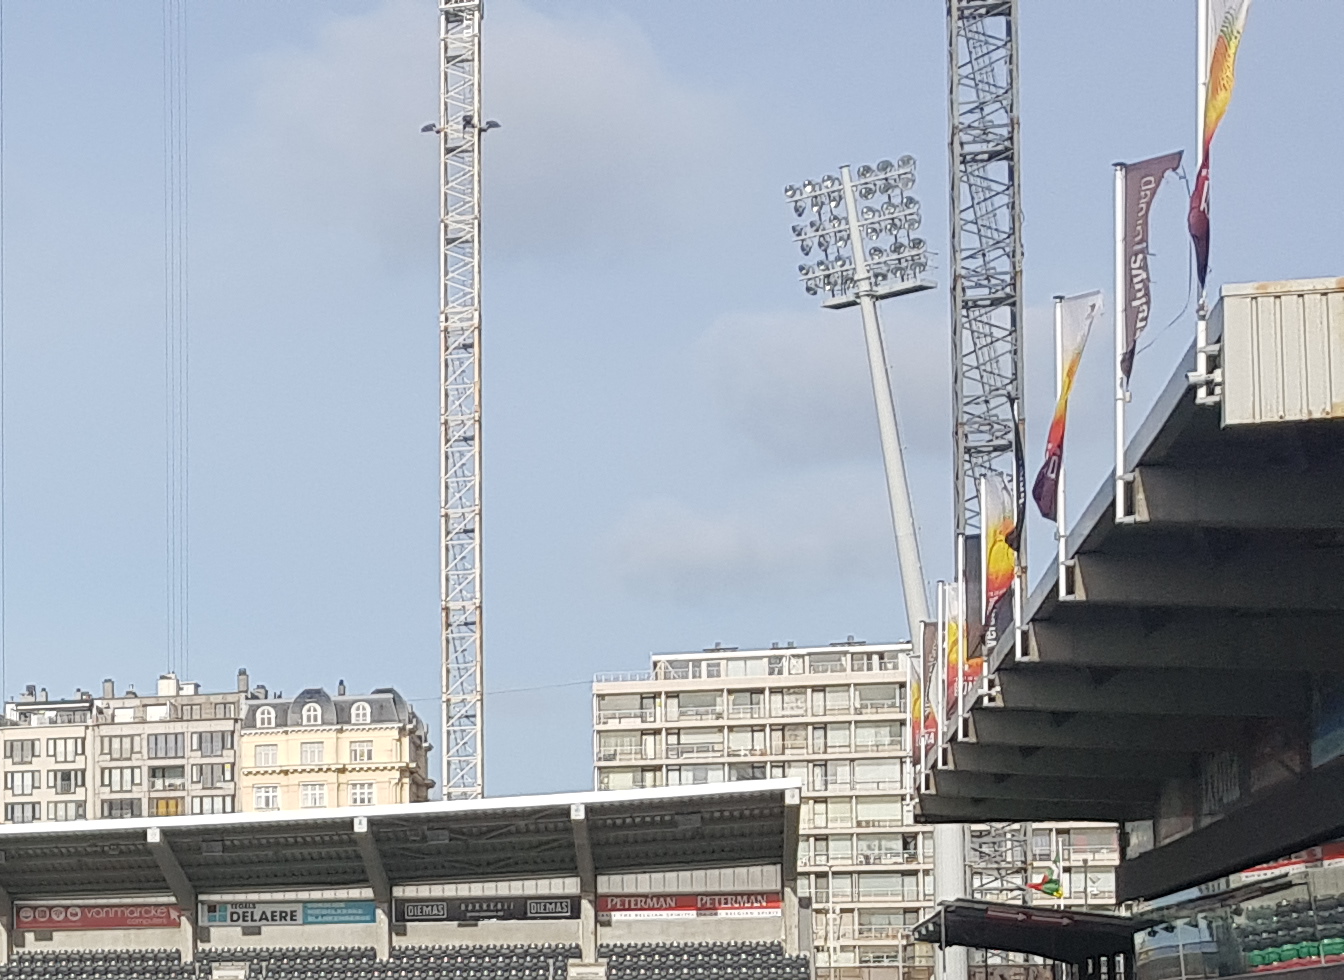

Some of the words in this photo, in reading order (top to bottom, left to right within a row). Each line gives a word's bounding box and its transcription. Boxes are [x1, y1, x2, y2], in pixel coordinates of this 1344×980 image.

[530, 901, 568, 914] DIEMAS
[607, 896, 676, 909] PETERMAN
[697, 895, 767, 908] PETERMAN
[85, 906, 168, 919] vanmarcke
[229, 910, 298, 923] DELAERE
[407, 904, 444, 917] DIEMAS
